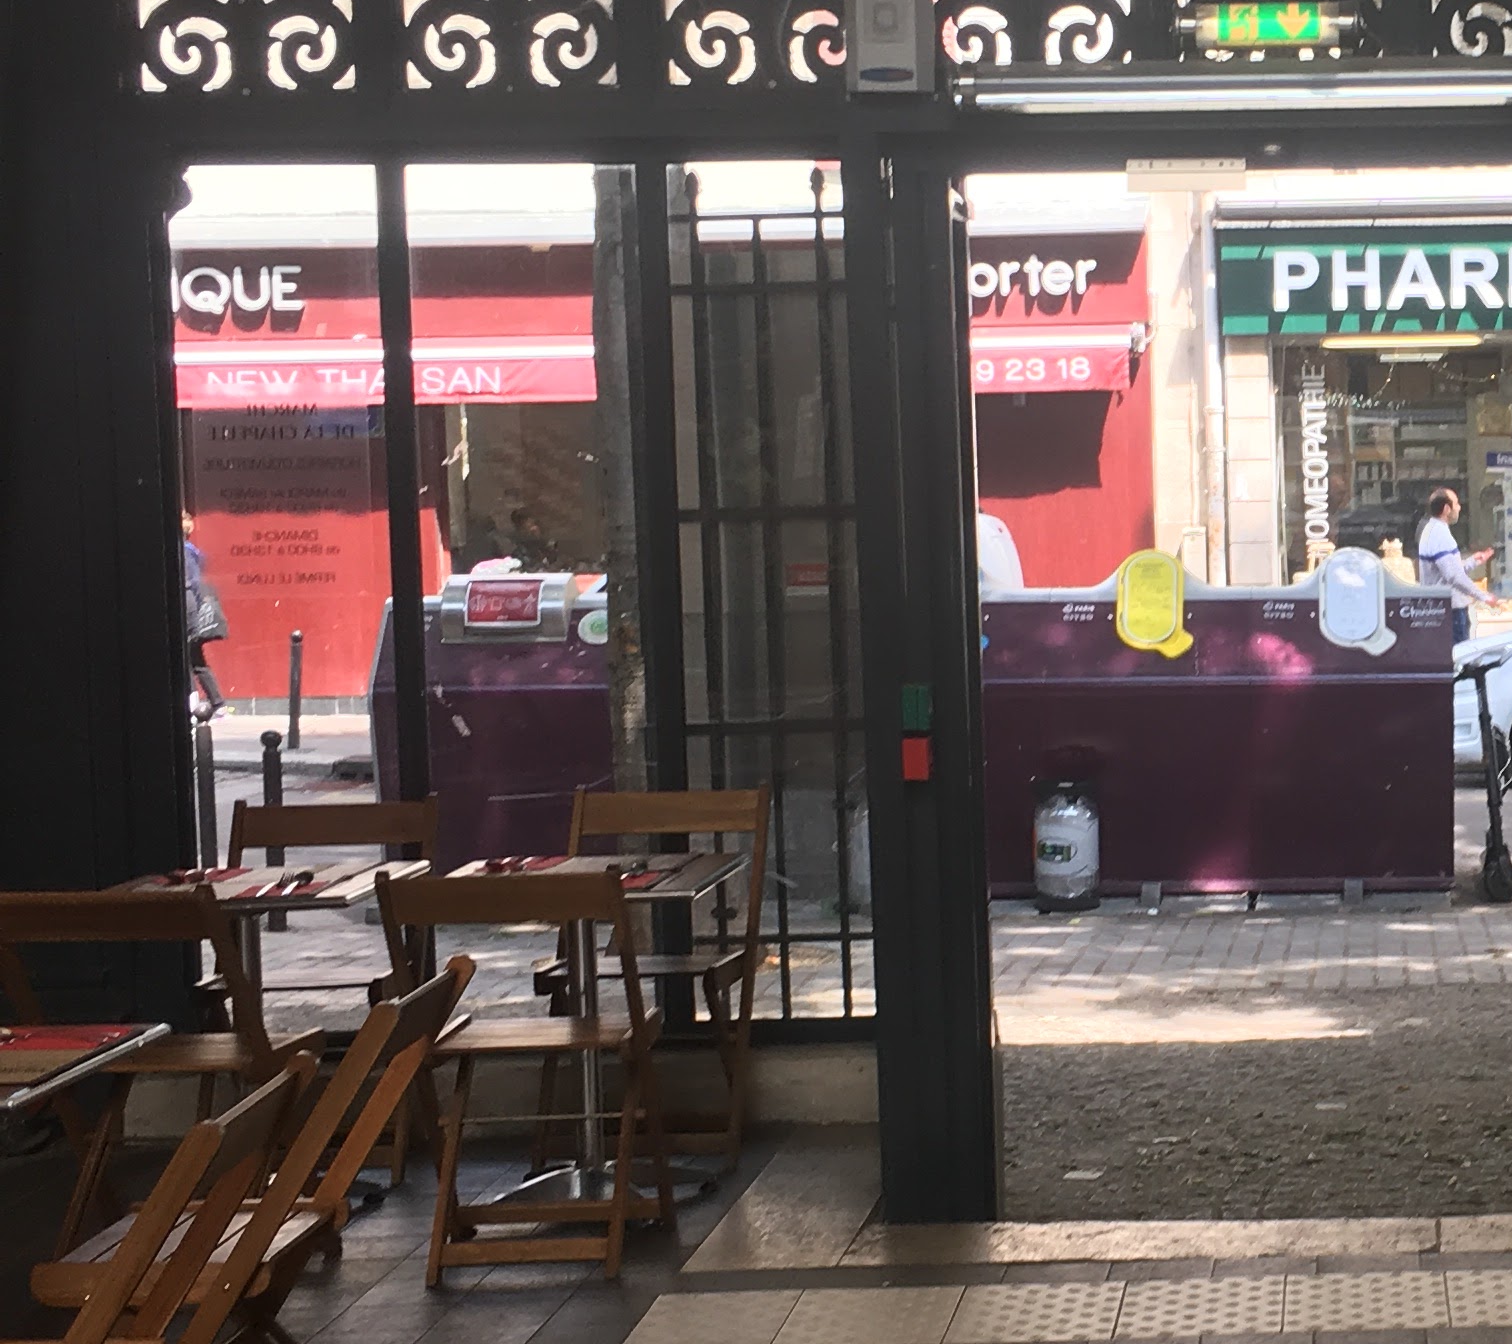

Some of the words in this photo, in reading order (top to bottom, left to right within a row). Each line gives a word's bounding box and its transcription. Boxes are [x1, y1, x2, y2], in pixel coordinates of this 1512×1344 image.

[968, 254, 1098, 298] orter
[206, 368, 299, 395] NEW
[316, 367, 384, 394] THA
[421, 366, 503, 394] SAN
[1004, 358, 1046, 381] 23
[1056, 356, 1091, 381] 18
